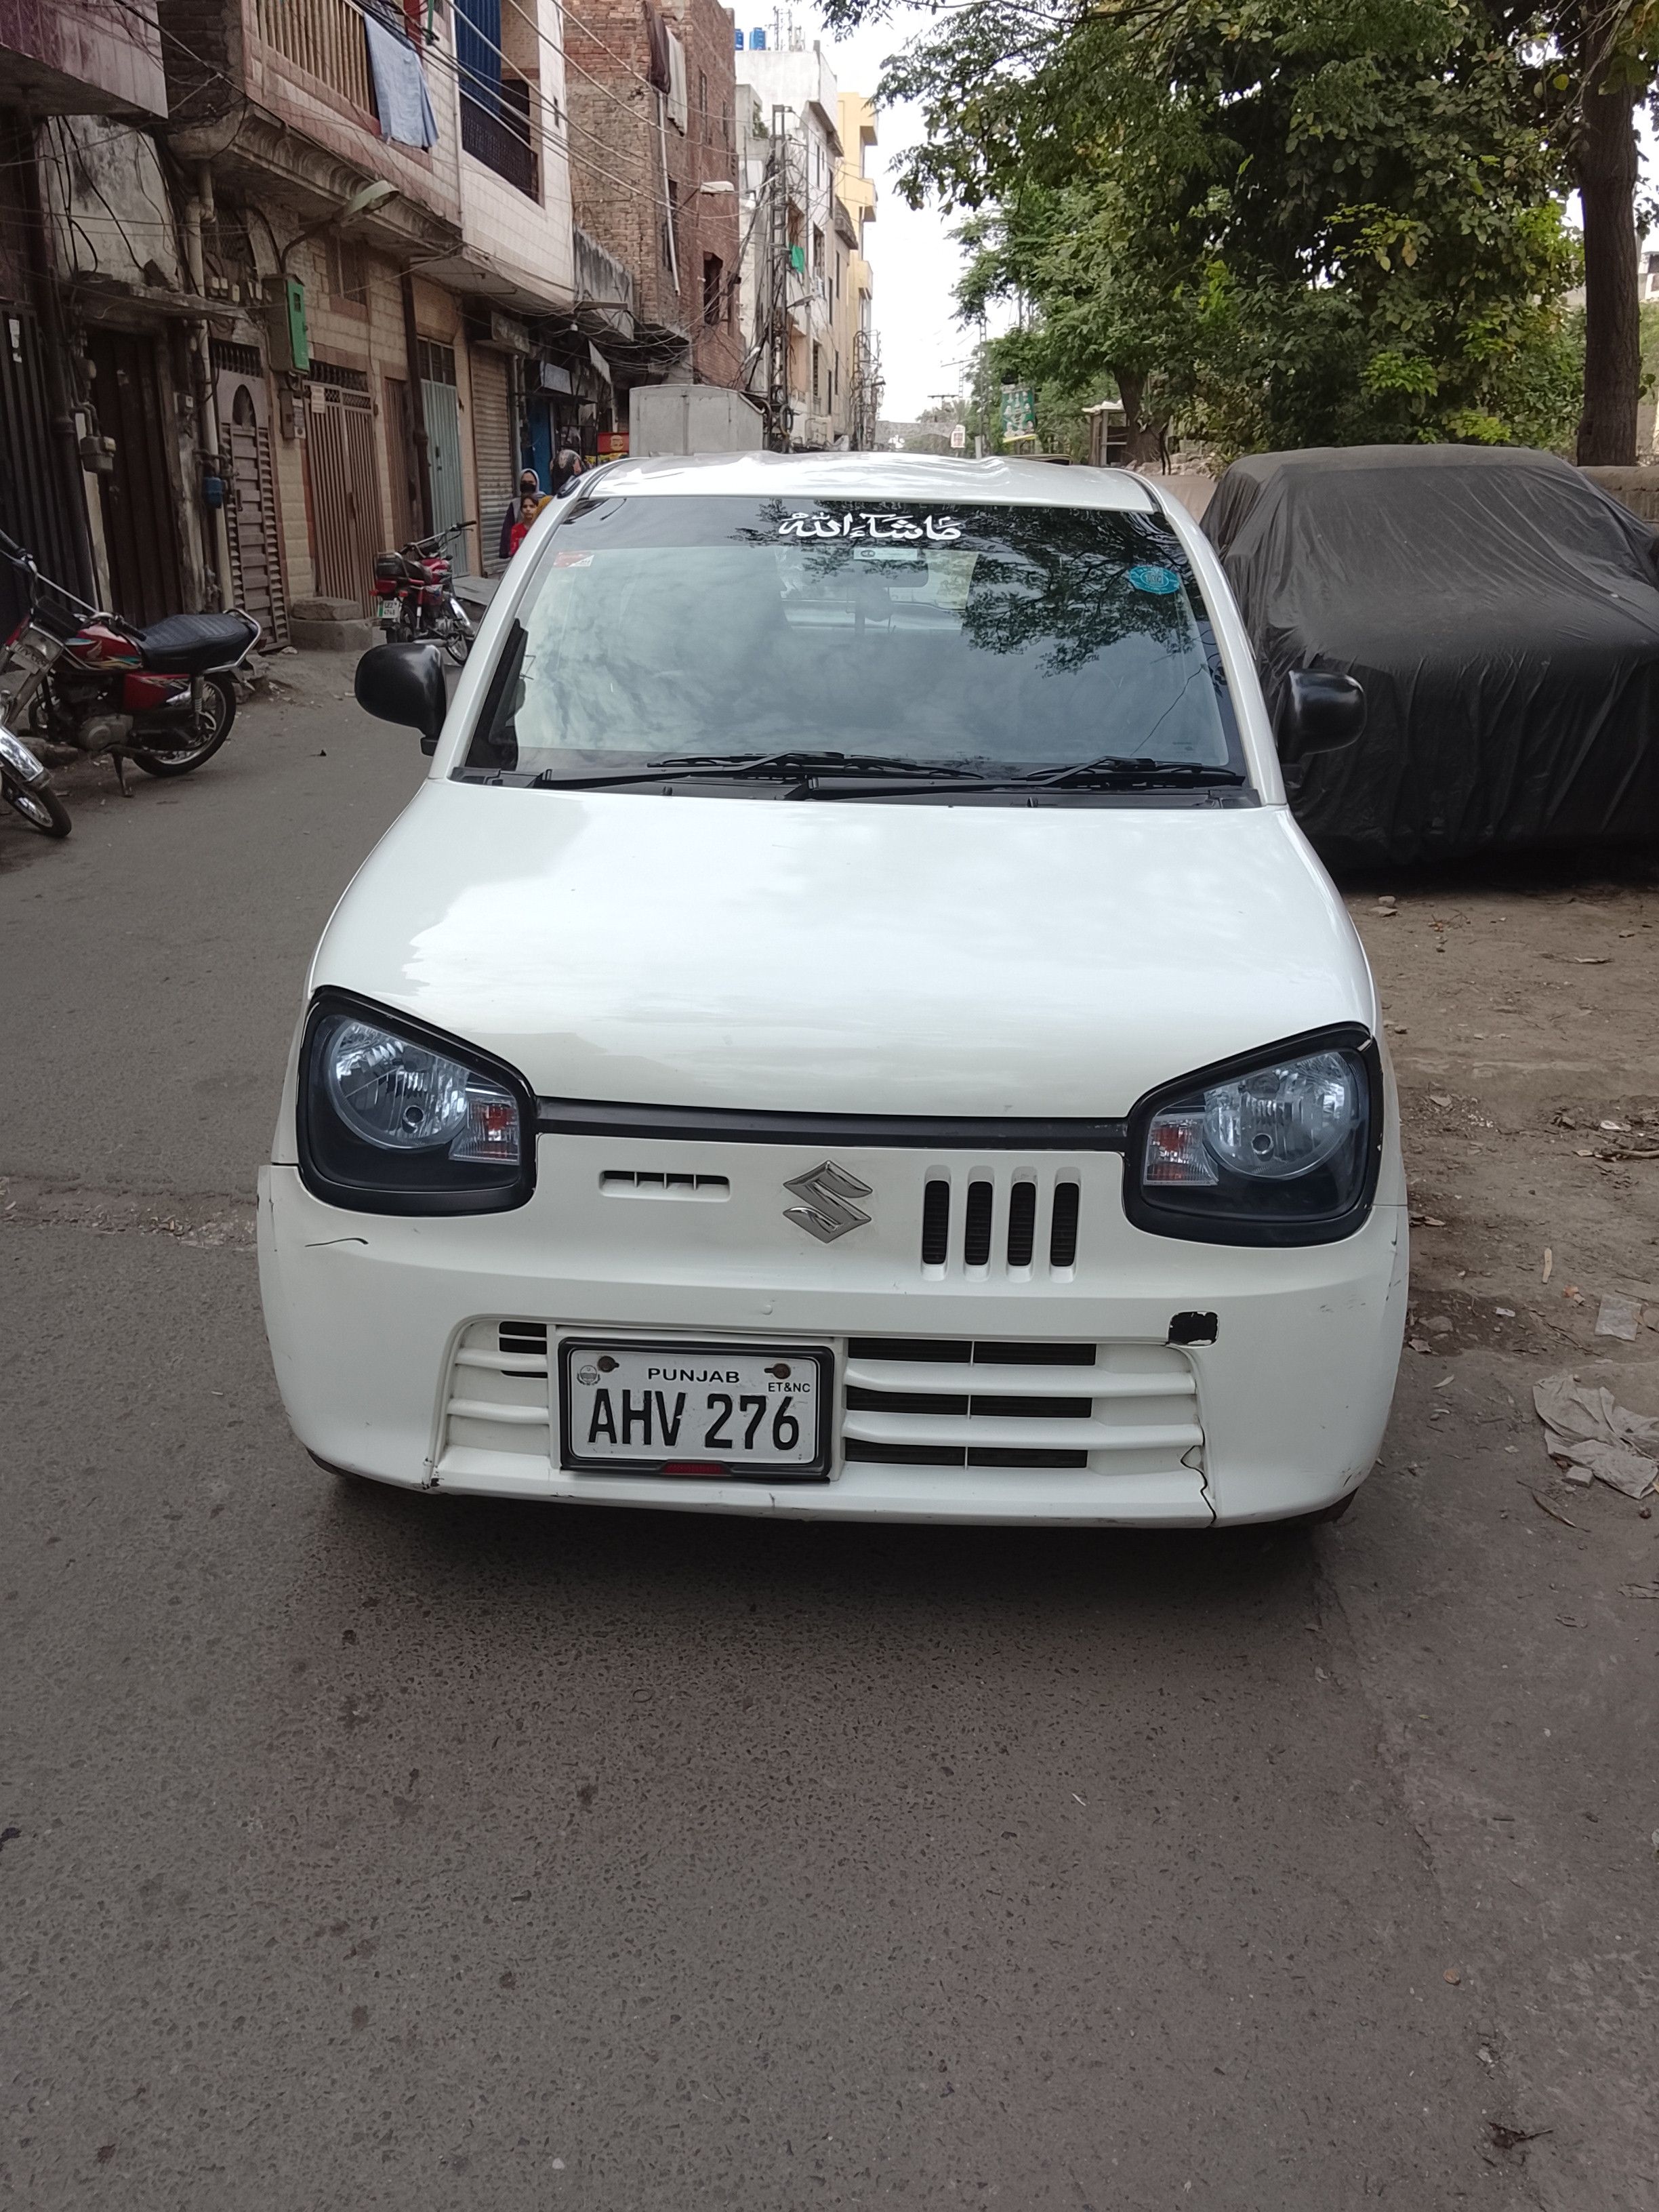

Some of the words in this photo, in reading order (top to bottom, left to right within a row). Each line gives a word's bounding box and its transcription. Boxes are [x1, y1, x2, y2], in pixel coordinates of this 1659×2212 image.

[648, 1368, 740, 1383] PUNJAB
[768, 1382, 811, 1393] ET&NC
[588, 1388, 687, 1447] AHV
[704, 1393, 800, 1451] 276
